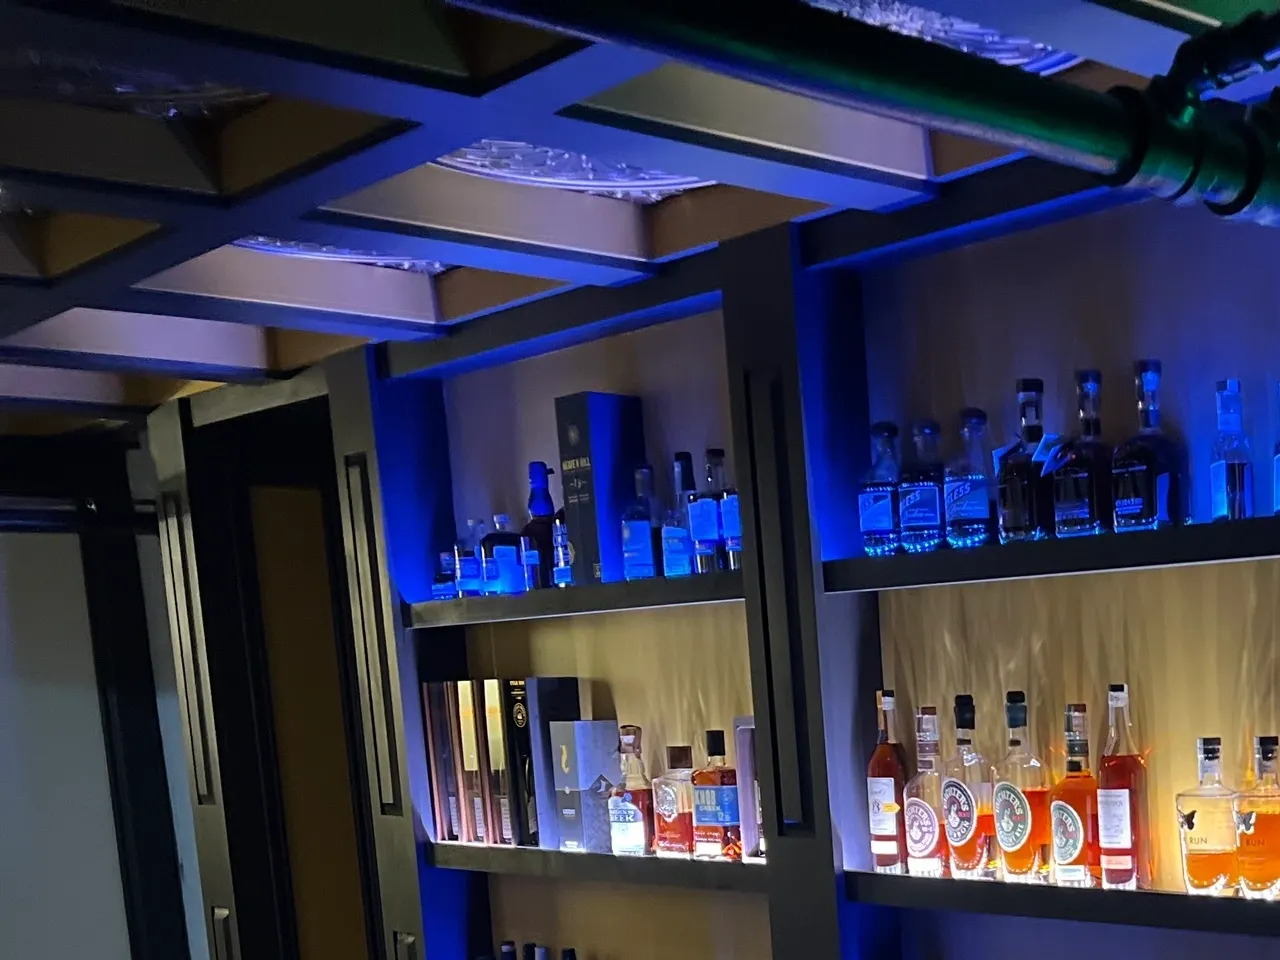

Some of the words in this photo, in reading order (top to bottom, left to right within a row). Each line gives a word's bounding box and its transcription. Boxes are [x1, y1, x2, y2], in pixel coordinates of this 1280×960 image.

[695, 789, 717, 806] KNOB
[1189, 837, 1208, 845] RUN
[1246, 839, 1265, 847] RUN
